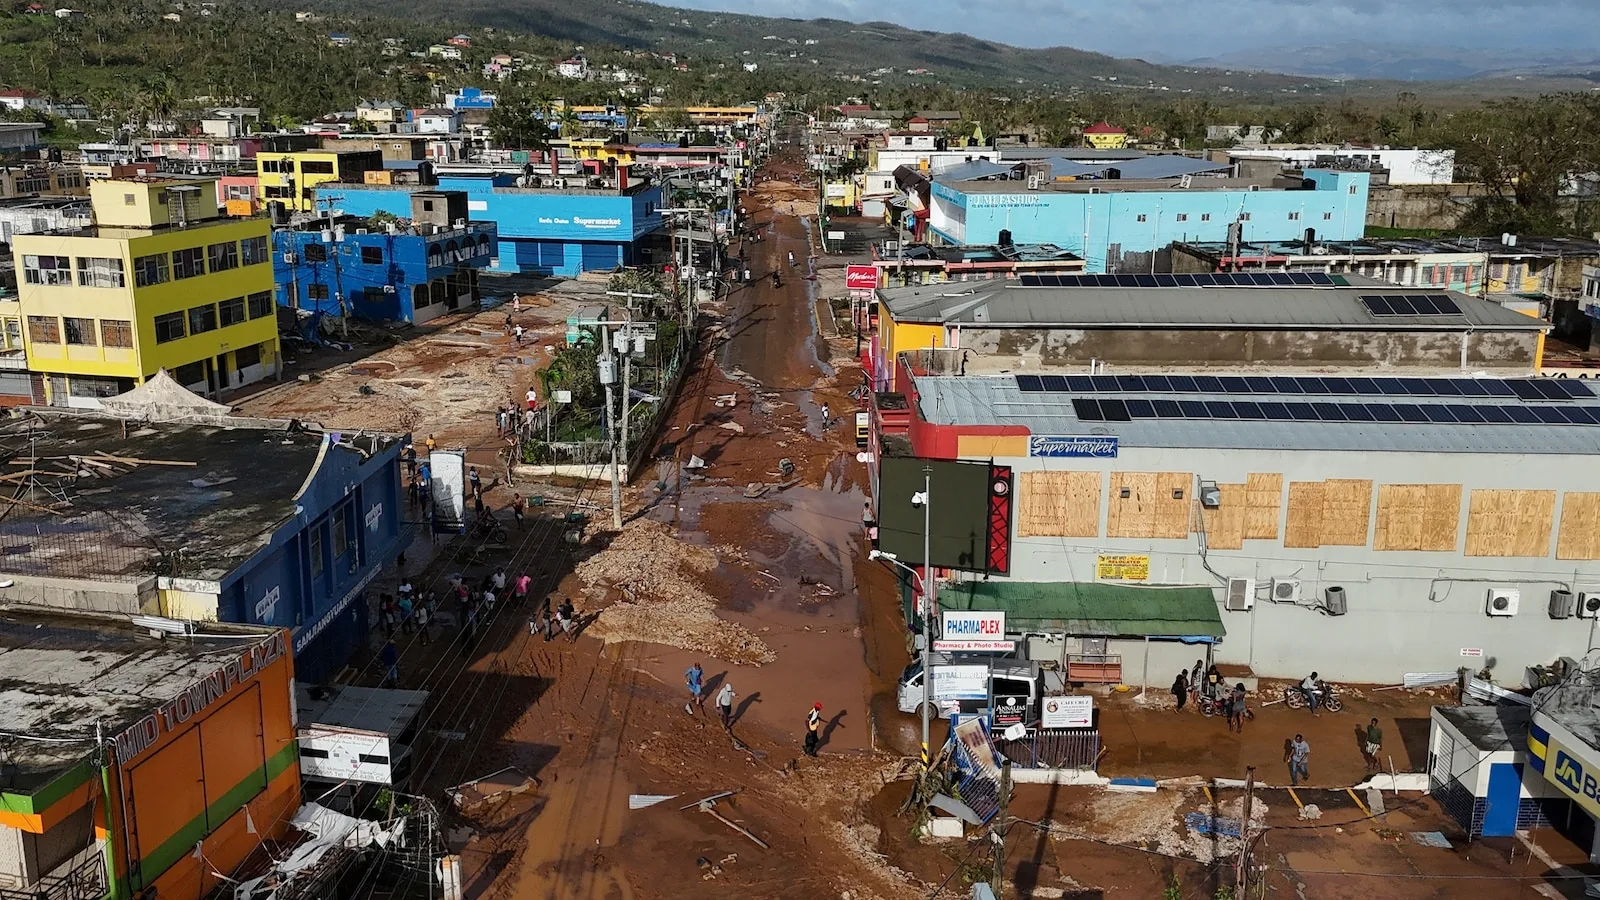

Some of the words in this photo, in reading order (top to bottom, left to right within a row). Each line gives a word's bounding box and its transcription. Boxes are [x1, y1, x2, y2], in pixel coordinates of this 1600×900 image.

[573, 216, 621, 226] Supermarket
[1031, 437, 1117, 457] Supermarket
[947, 620, 1000, 634] PHARMAPLEX
[115, 713, 160, 765] MID
[158, 670, 224, 733] TOWN
[222, 632, 287, 693] PLAZA
